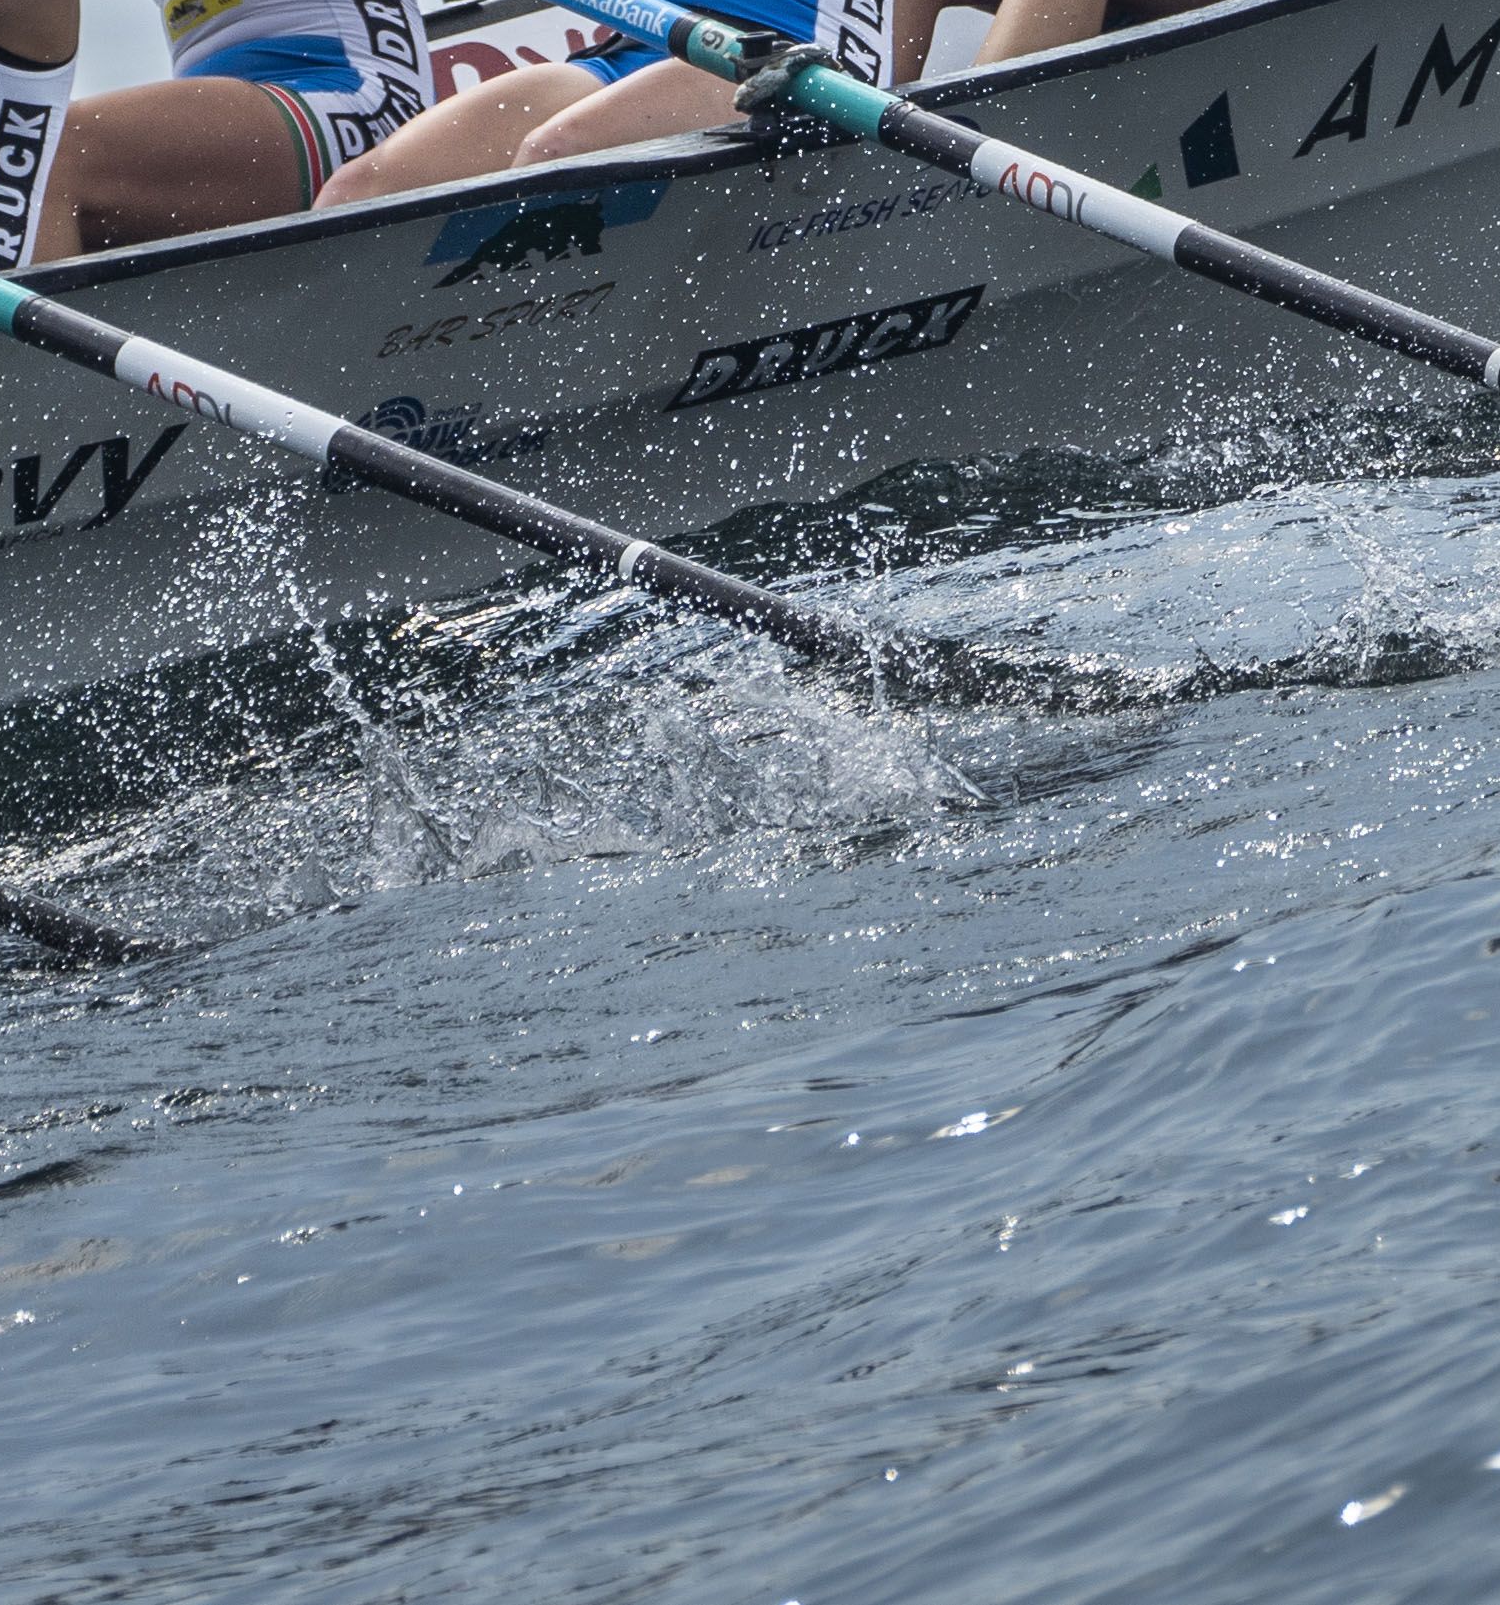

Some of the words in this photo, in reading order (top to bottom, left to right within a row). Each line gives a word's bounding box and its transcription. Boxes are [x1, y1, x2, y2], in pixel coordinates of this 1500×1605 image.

[377, 315, 469, 358] BAR
[469, 281, 617, 342] SPORT
[681, 296, 967, 402] DRUCK
